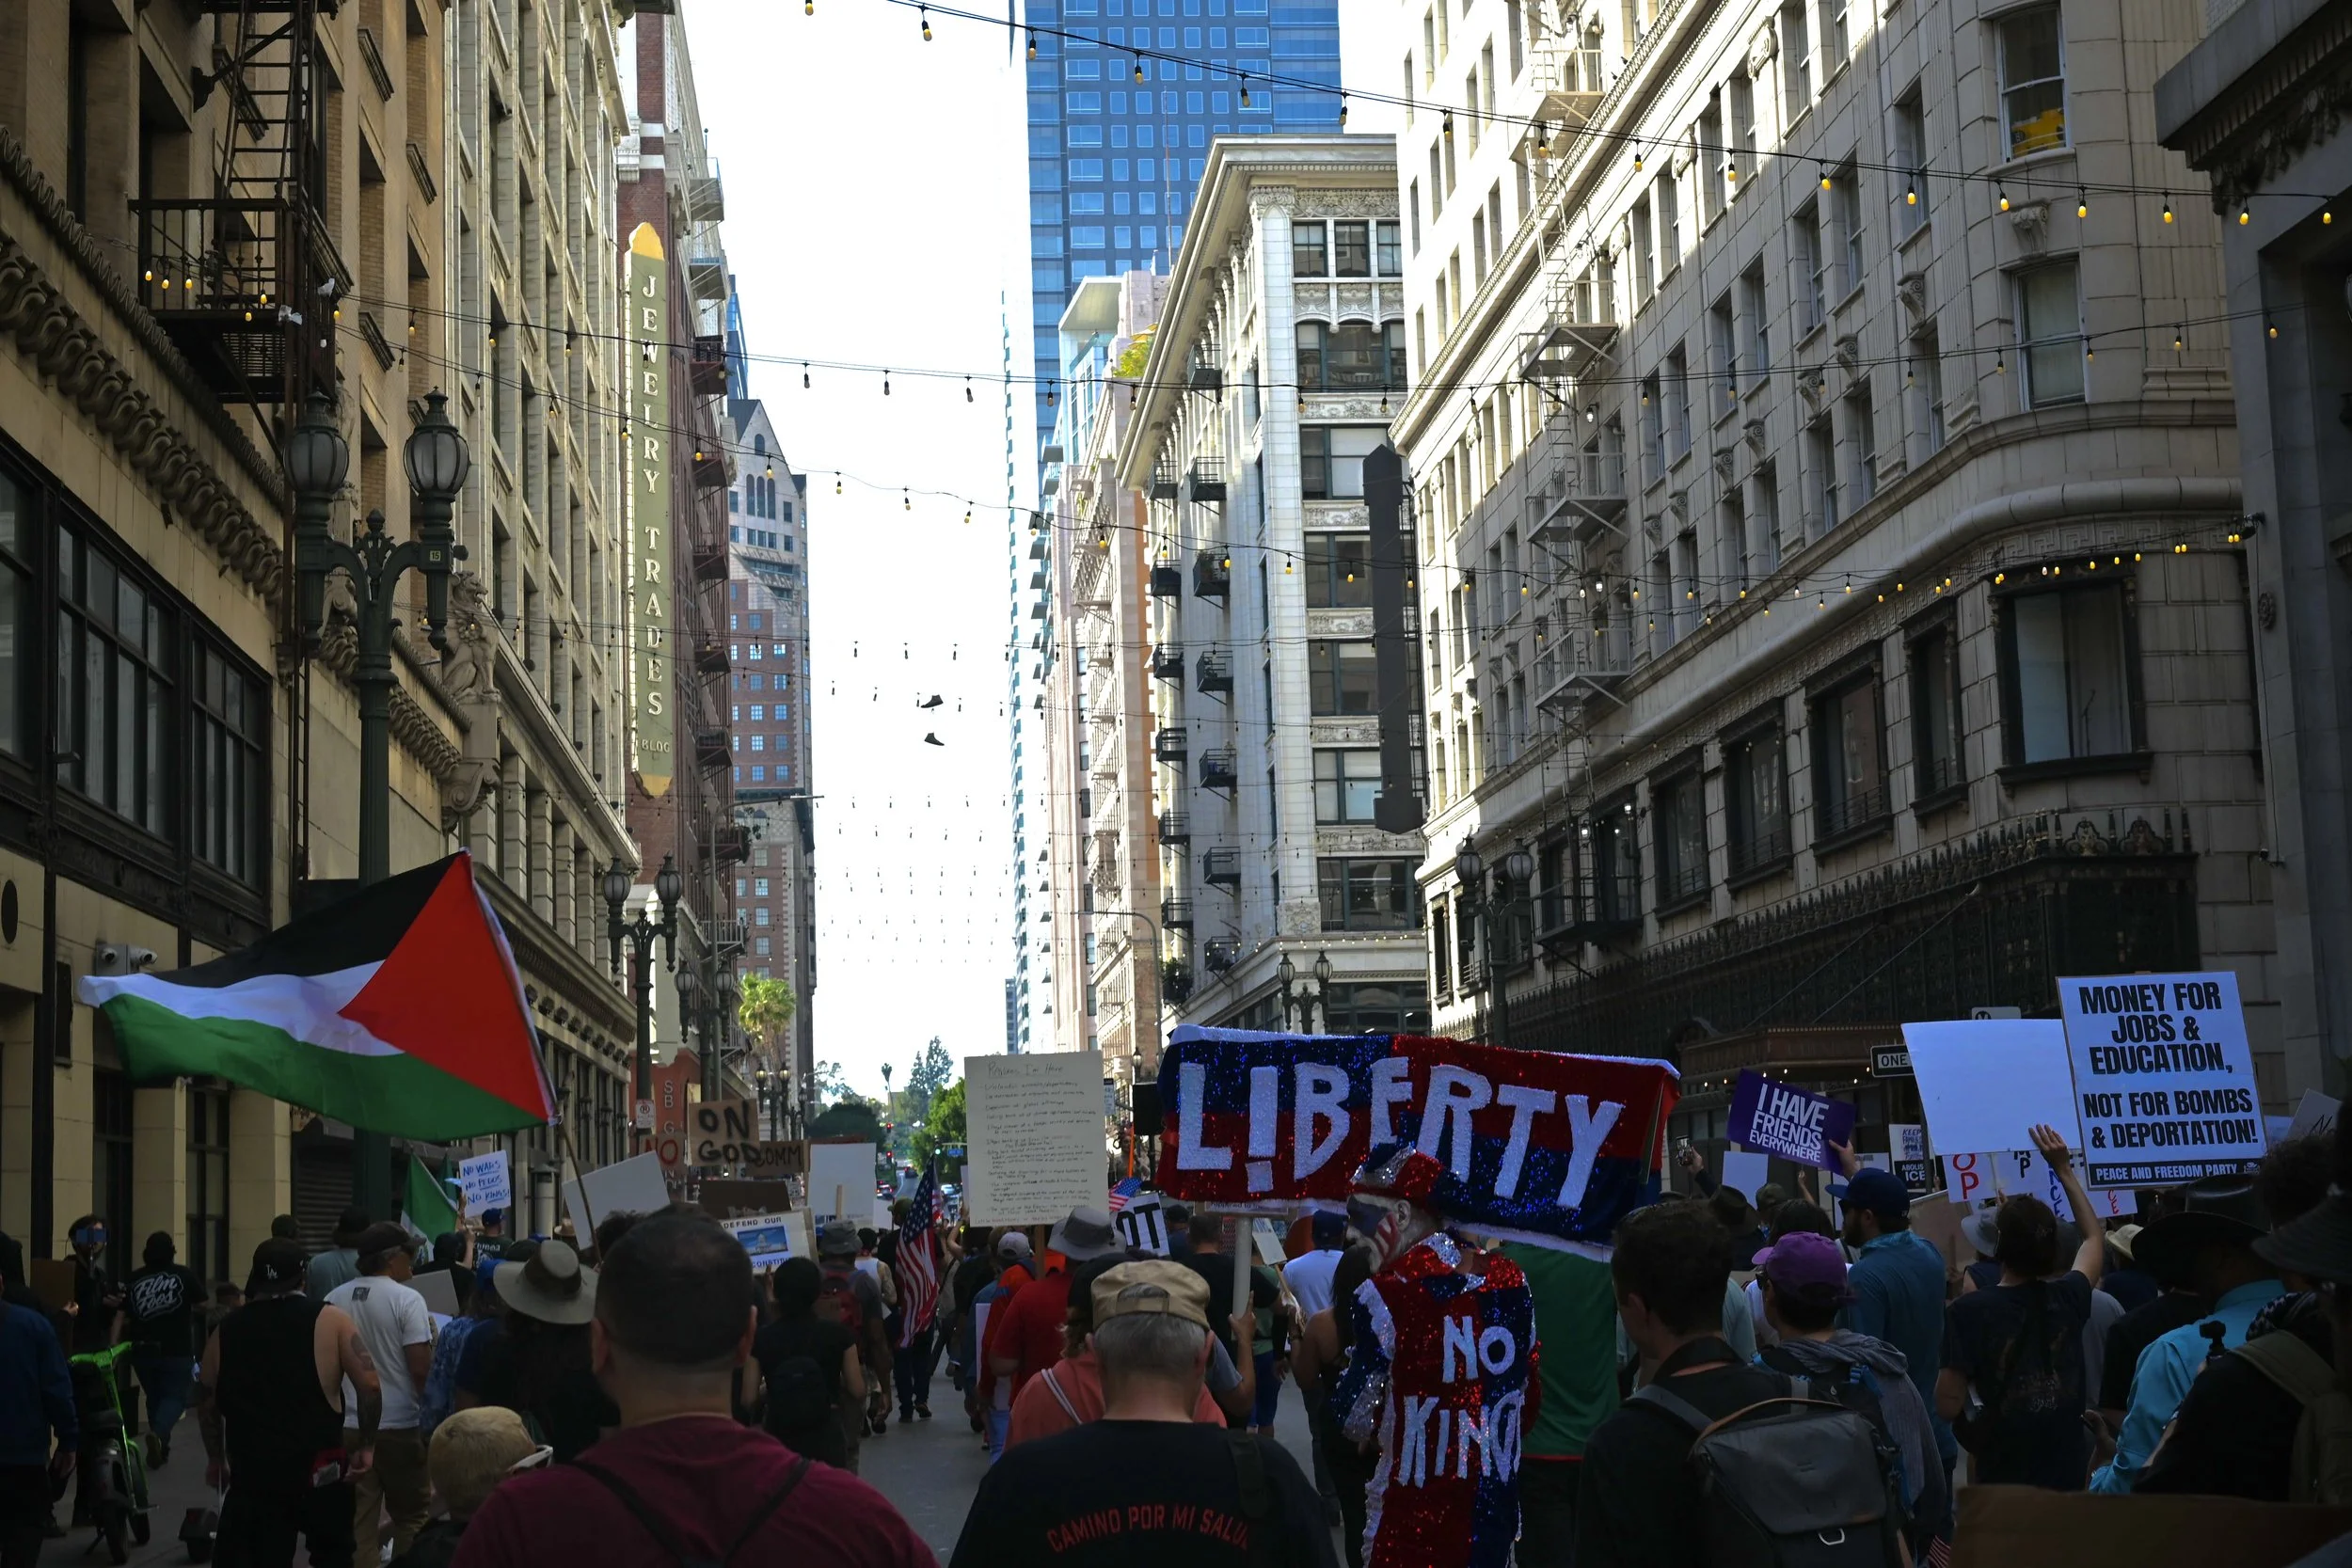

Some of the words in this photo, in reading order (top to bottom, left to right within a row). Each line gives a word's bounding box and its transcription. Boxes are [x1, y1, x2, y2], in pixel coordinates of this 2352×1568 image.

[642, 275, 660, 494] JEWELRY
[644, 526, 662, 715] TRADES
[2078, 984, 2165, 1014] MONEY
[2172, 982, 2222, 1011] FOR
[2111, 1014, 2176, 1043] JOBS
[2183, 1016, 2201, 1041] &
[1882, 1054, 1908, 1067] ONE
[2089, 1042, 2233, 1075] EDUCATION,
[1756, 1083, 1768, 1111] I
[1770, 1087, 1829, 1132] HAVE
[2082, 1093, 2122, 1118] NOT
[2128, 1091, 2170, 1117] FOR
[2173, 1088, 2253, 1116] BOMBS
[698, 1100, 751, 1139] ON
[1176, 1055, 1627, 1210] LIBERTY
[1752, 1110, 1822, 1150] FRIENDS
[2091, 1126, 2106, 1148] &
[2110, 1118, 2259, 1148] DEPORTATION!
[698, 1140, 760, 1164] GOD
[1749, 1129, 1821, 1163] EVERYWHERE
[463, 1166, 474, 1177] NO
[476, 1161, 501, 1174] WARS
[1901, 1164, 1924, 1172] ABOLIS
[1905, 1170, 1926, 1181] ICE
[2096, 1167, 2129, 1181] PEACE
[2131, 1166, 2153, 1180] AND
[2153, 1164, 2203, 1180] FREEDOM
[2205, 1164, 2237, 1177] PARTY
[466, 1180, 476, 1192] NO
[468, 1193, 482, 1205] NO
[723, 1219, 758, 1228] DEFEND
[1442, 1314, 1516, 1384] NO
[1046, 1509, 1120, 1552] CAMINO
[1128, 1505, 1165, 1530] POR
[1172, 1504, 1196, 1530] MI
